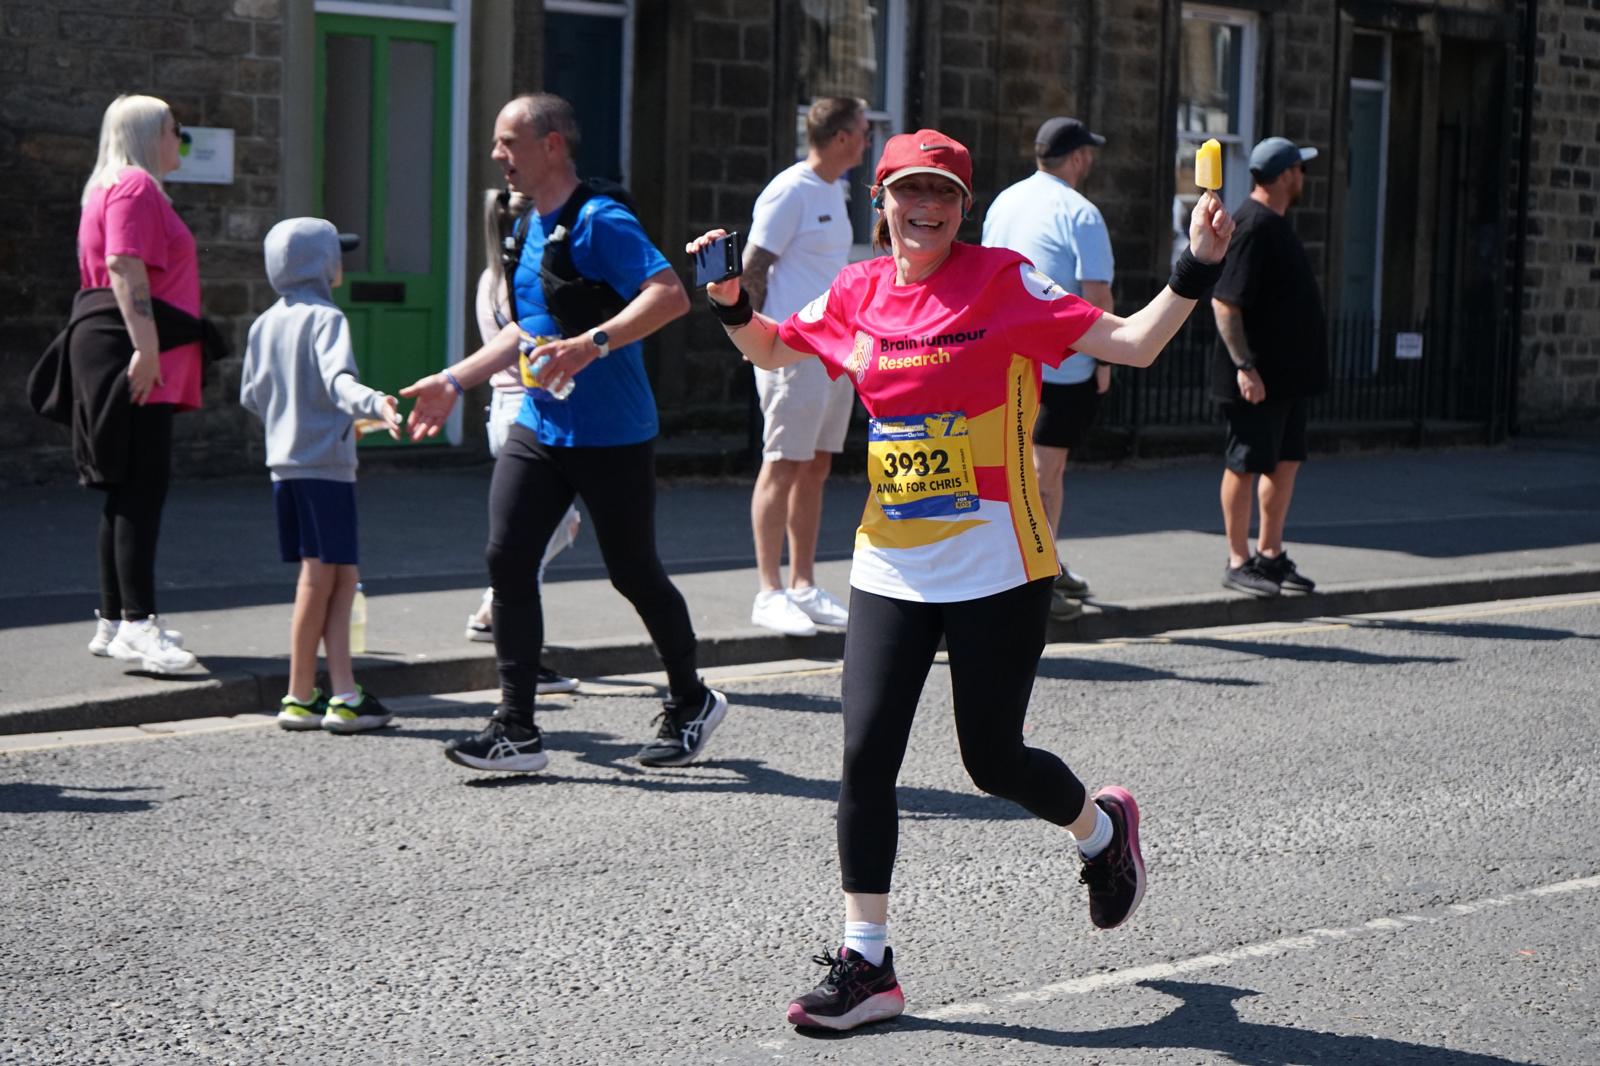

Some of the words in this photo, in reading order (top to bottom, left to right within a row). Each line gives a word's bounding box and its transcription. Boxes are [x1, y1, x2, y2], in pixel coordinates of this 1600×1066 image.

[880, 335, 918, 353] Brain
[921, 328, 987, 348] Tumour
[878, 347, 951, 371] Research
[941, 416, 957, 437] 7
[884, 449, 951, 478] 3932
[1016, 374, 1044, 554] www.braintumourresearch.org
[876, 482, 904, 494] ANNA
[906, 481, 927, 493] FOR
[929, 477, 962, 491] CHRIS
